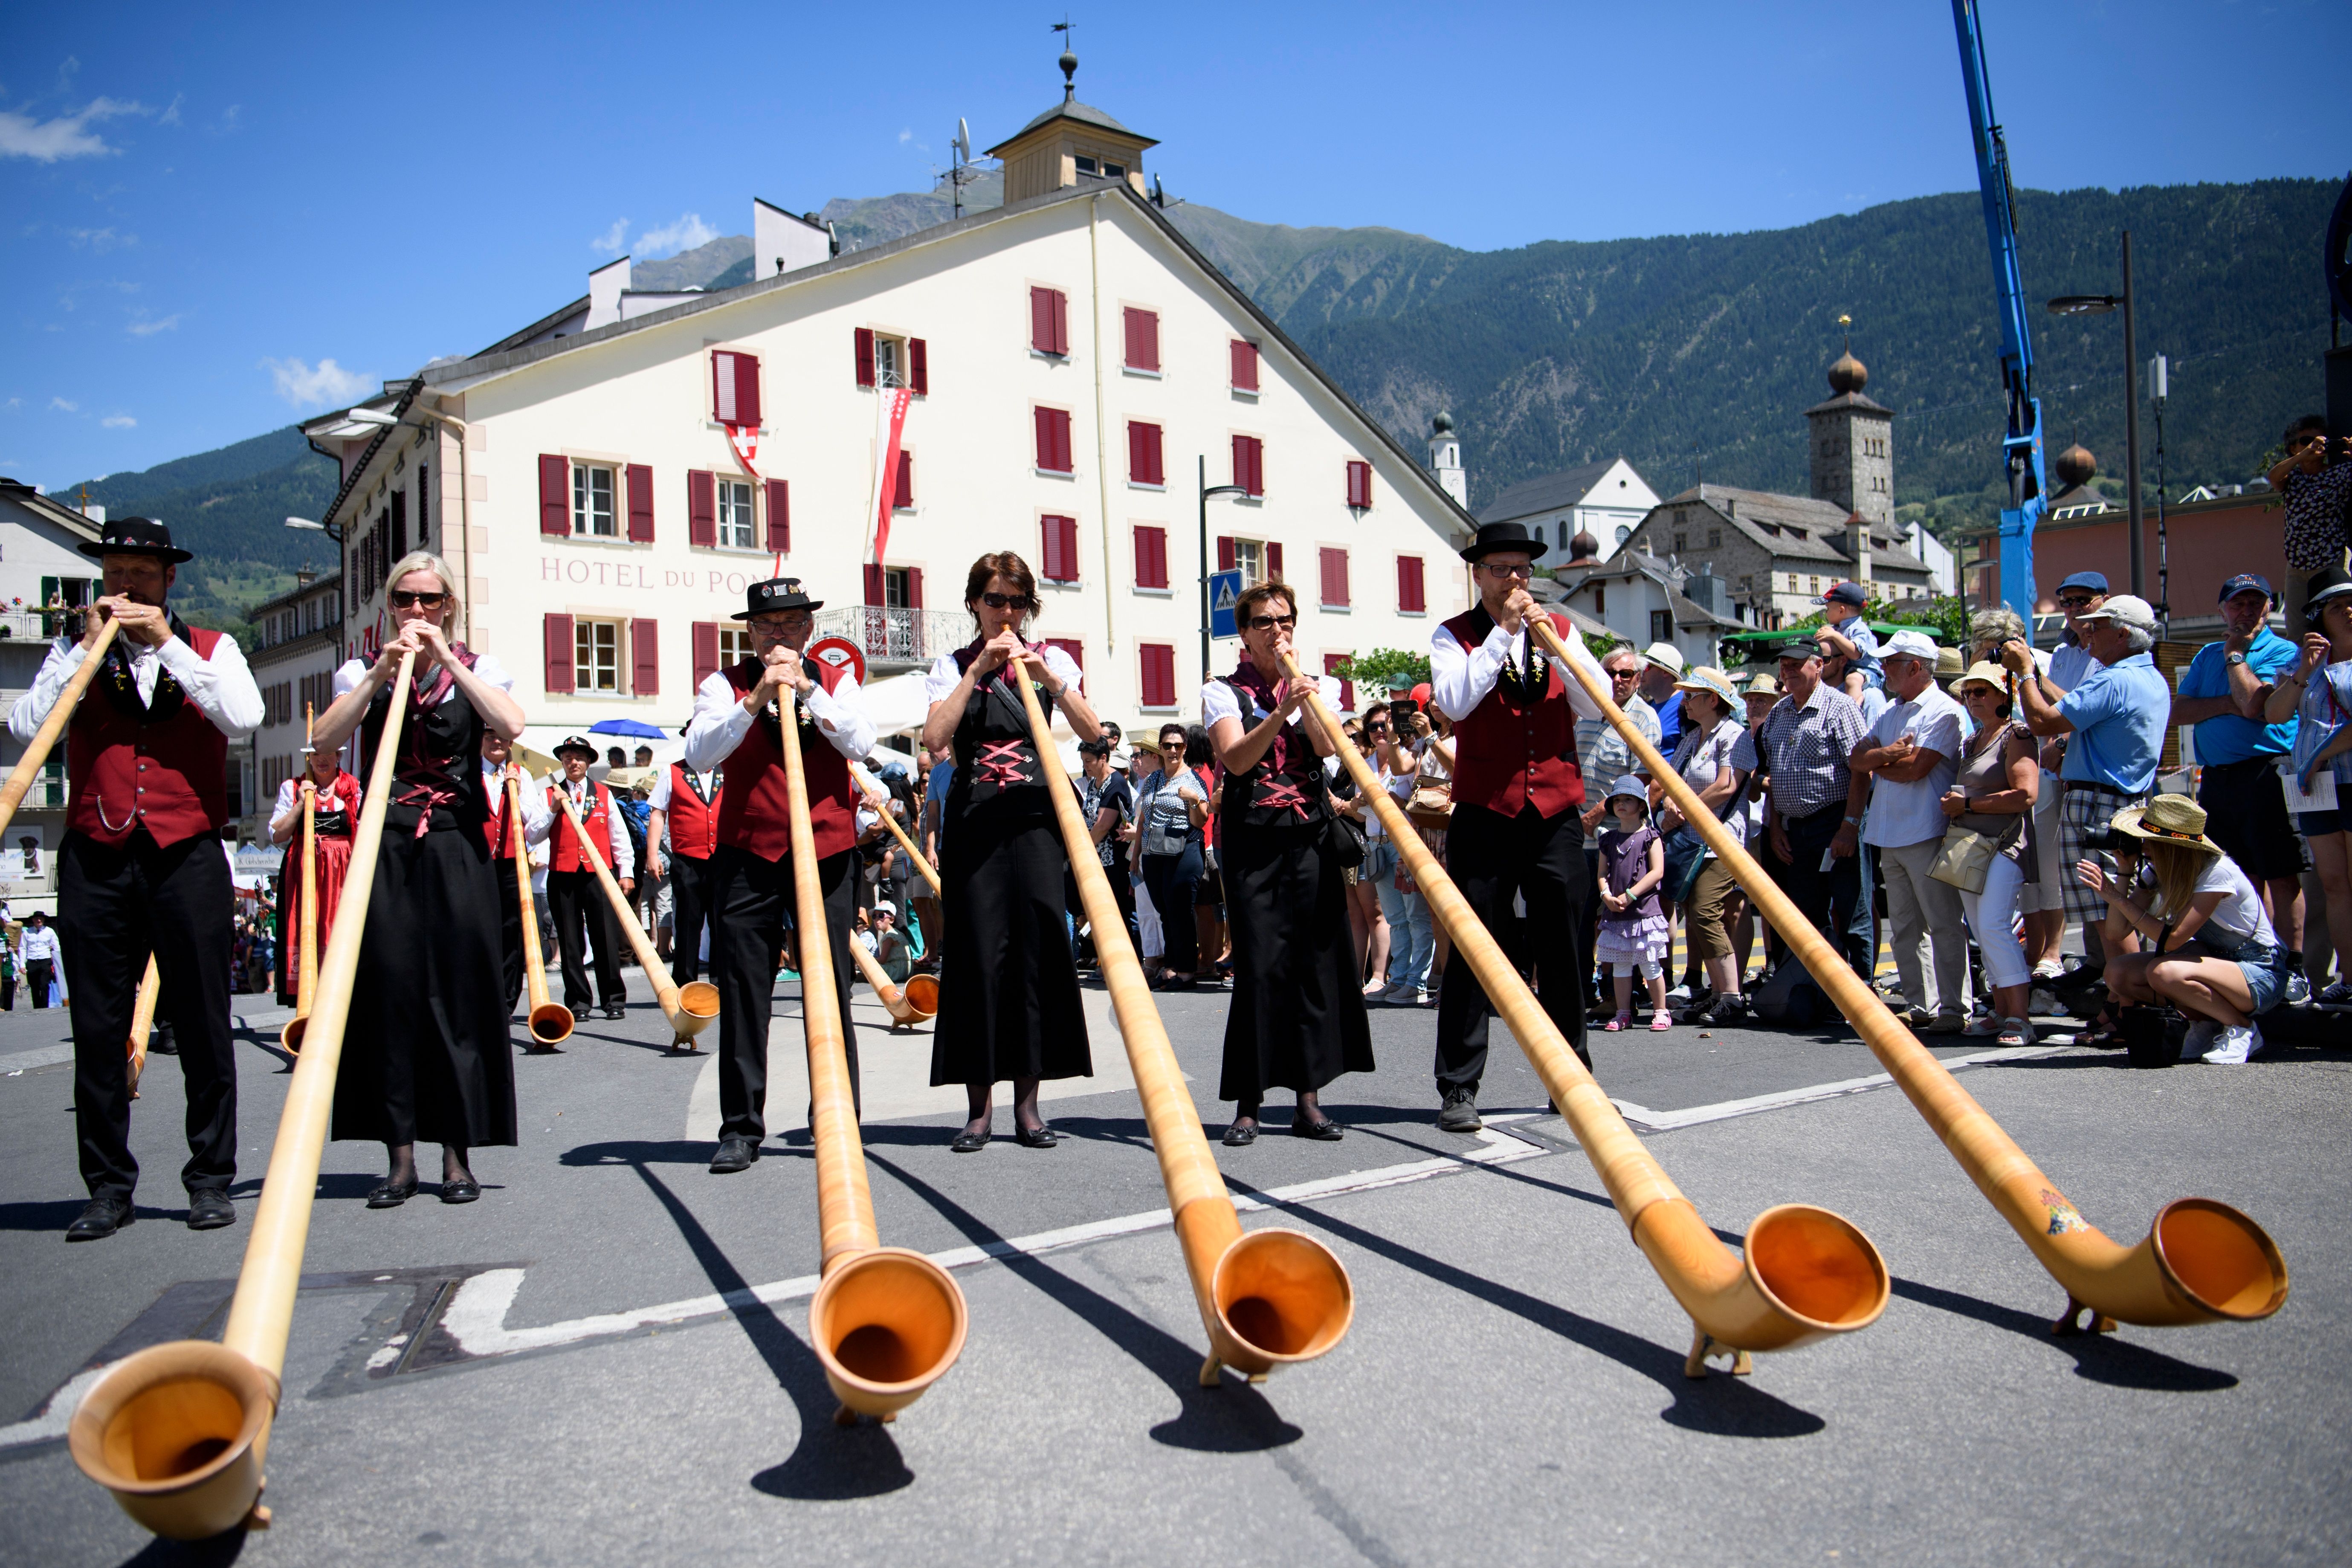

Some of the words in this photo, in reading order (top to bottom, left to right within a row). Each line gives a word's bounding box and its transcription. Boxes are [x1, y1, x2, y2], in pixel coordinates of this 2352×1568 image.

[540, 557, 655, 589] HOTEL
[665, 571, 695, 587] DU
[707, 571, 787, 595] PO
[2143, 823, 2161, 832] coop
